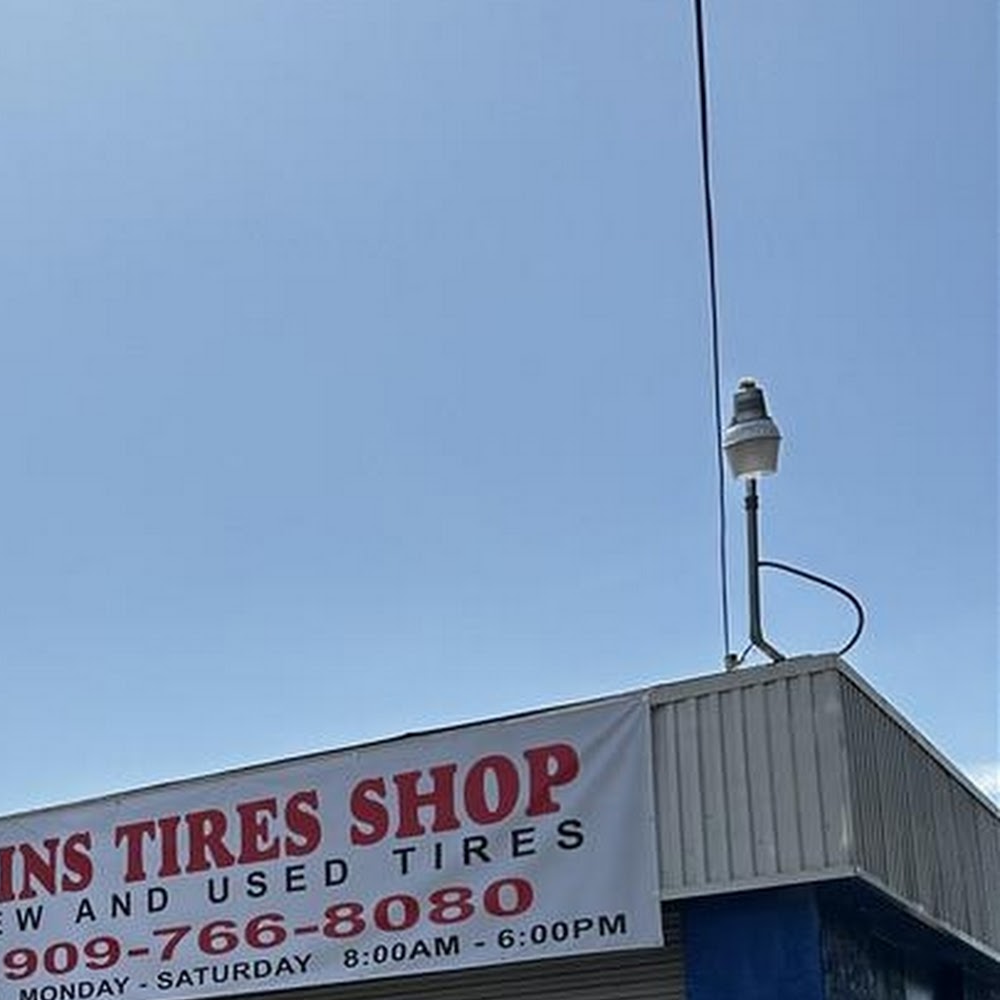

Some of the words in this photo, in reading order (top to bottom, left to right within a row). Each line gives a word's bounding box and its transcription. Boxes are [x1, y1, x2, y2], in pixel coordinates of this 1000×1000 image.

[115, 790, 322, 884] TIRES
[350, 743, 580, 846] SHOP
[76, 887, 169, 923] AND
[208, 859, 348, 904] USED
[393, 819, 585, 875] TIRES
[3, 877, 534, 981] 909-766-8080
[157, 954, 312, 990] SATURDAY
[344, 935, 460, 968] 8:00AM
[497, 913, 627, 949] 6:00PM
